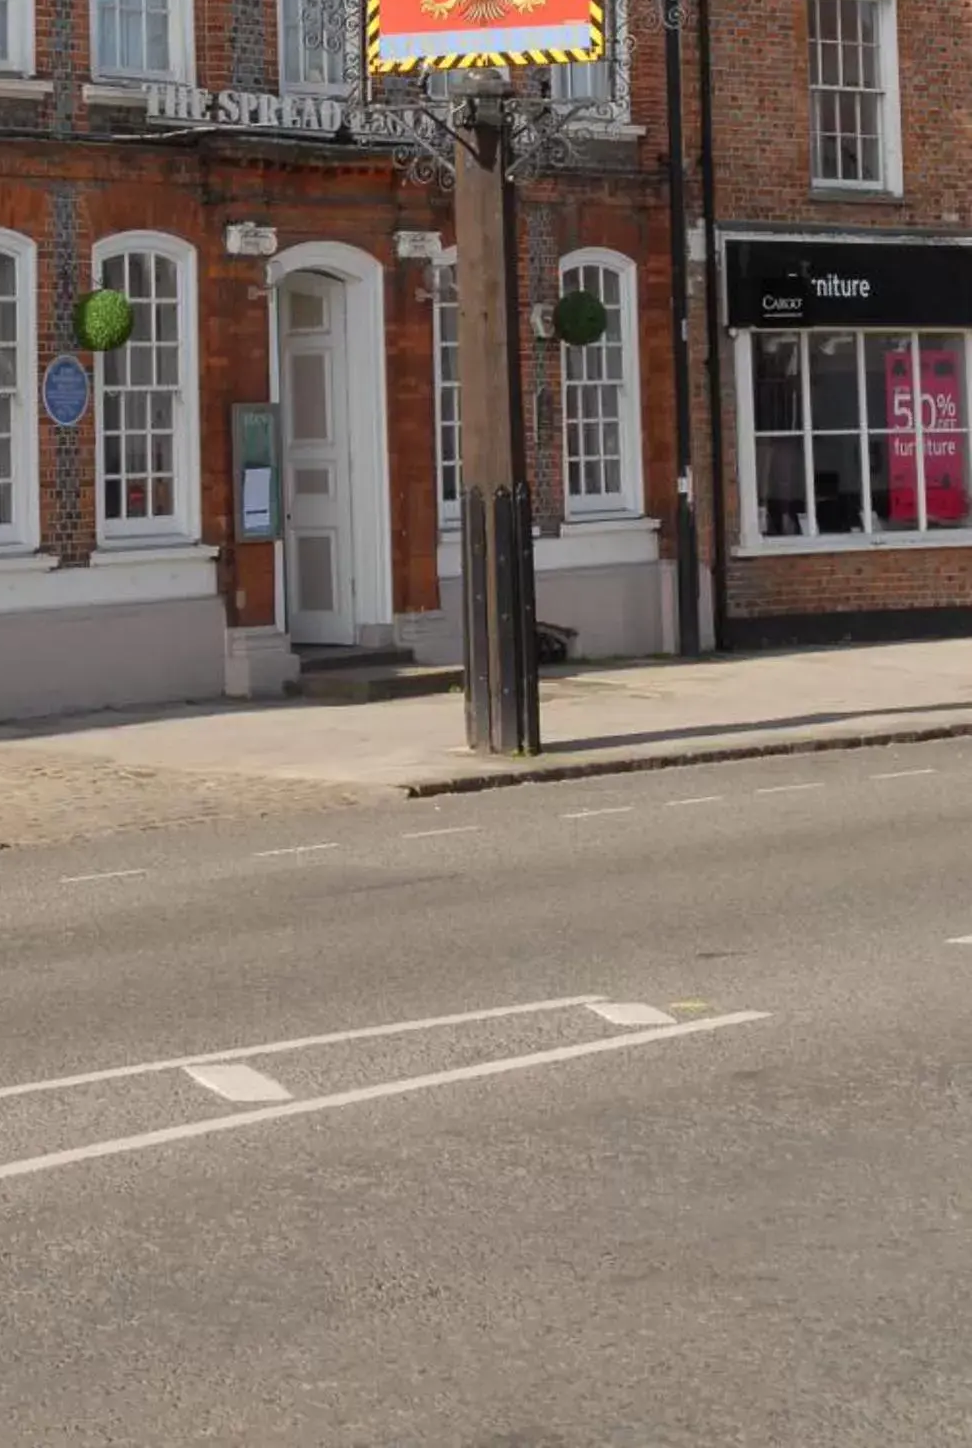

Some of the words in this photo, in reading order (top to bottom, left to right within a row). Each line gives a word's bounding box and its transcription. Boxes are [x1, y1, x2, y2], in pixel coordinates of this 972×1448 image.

[142, 83, 212, 120] THE
[811, 273, 871, 297] niture
[893, 437, 956, 456] furture
